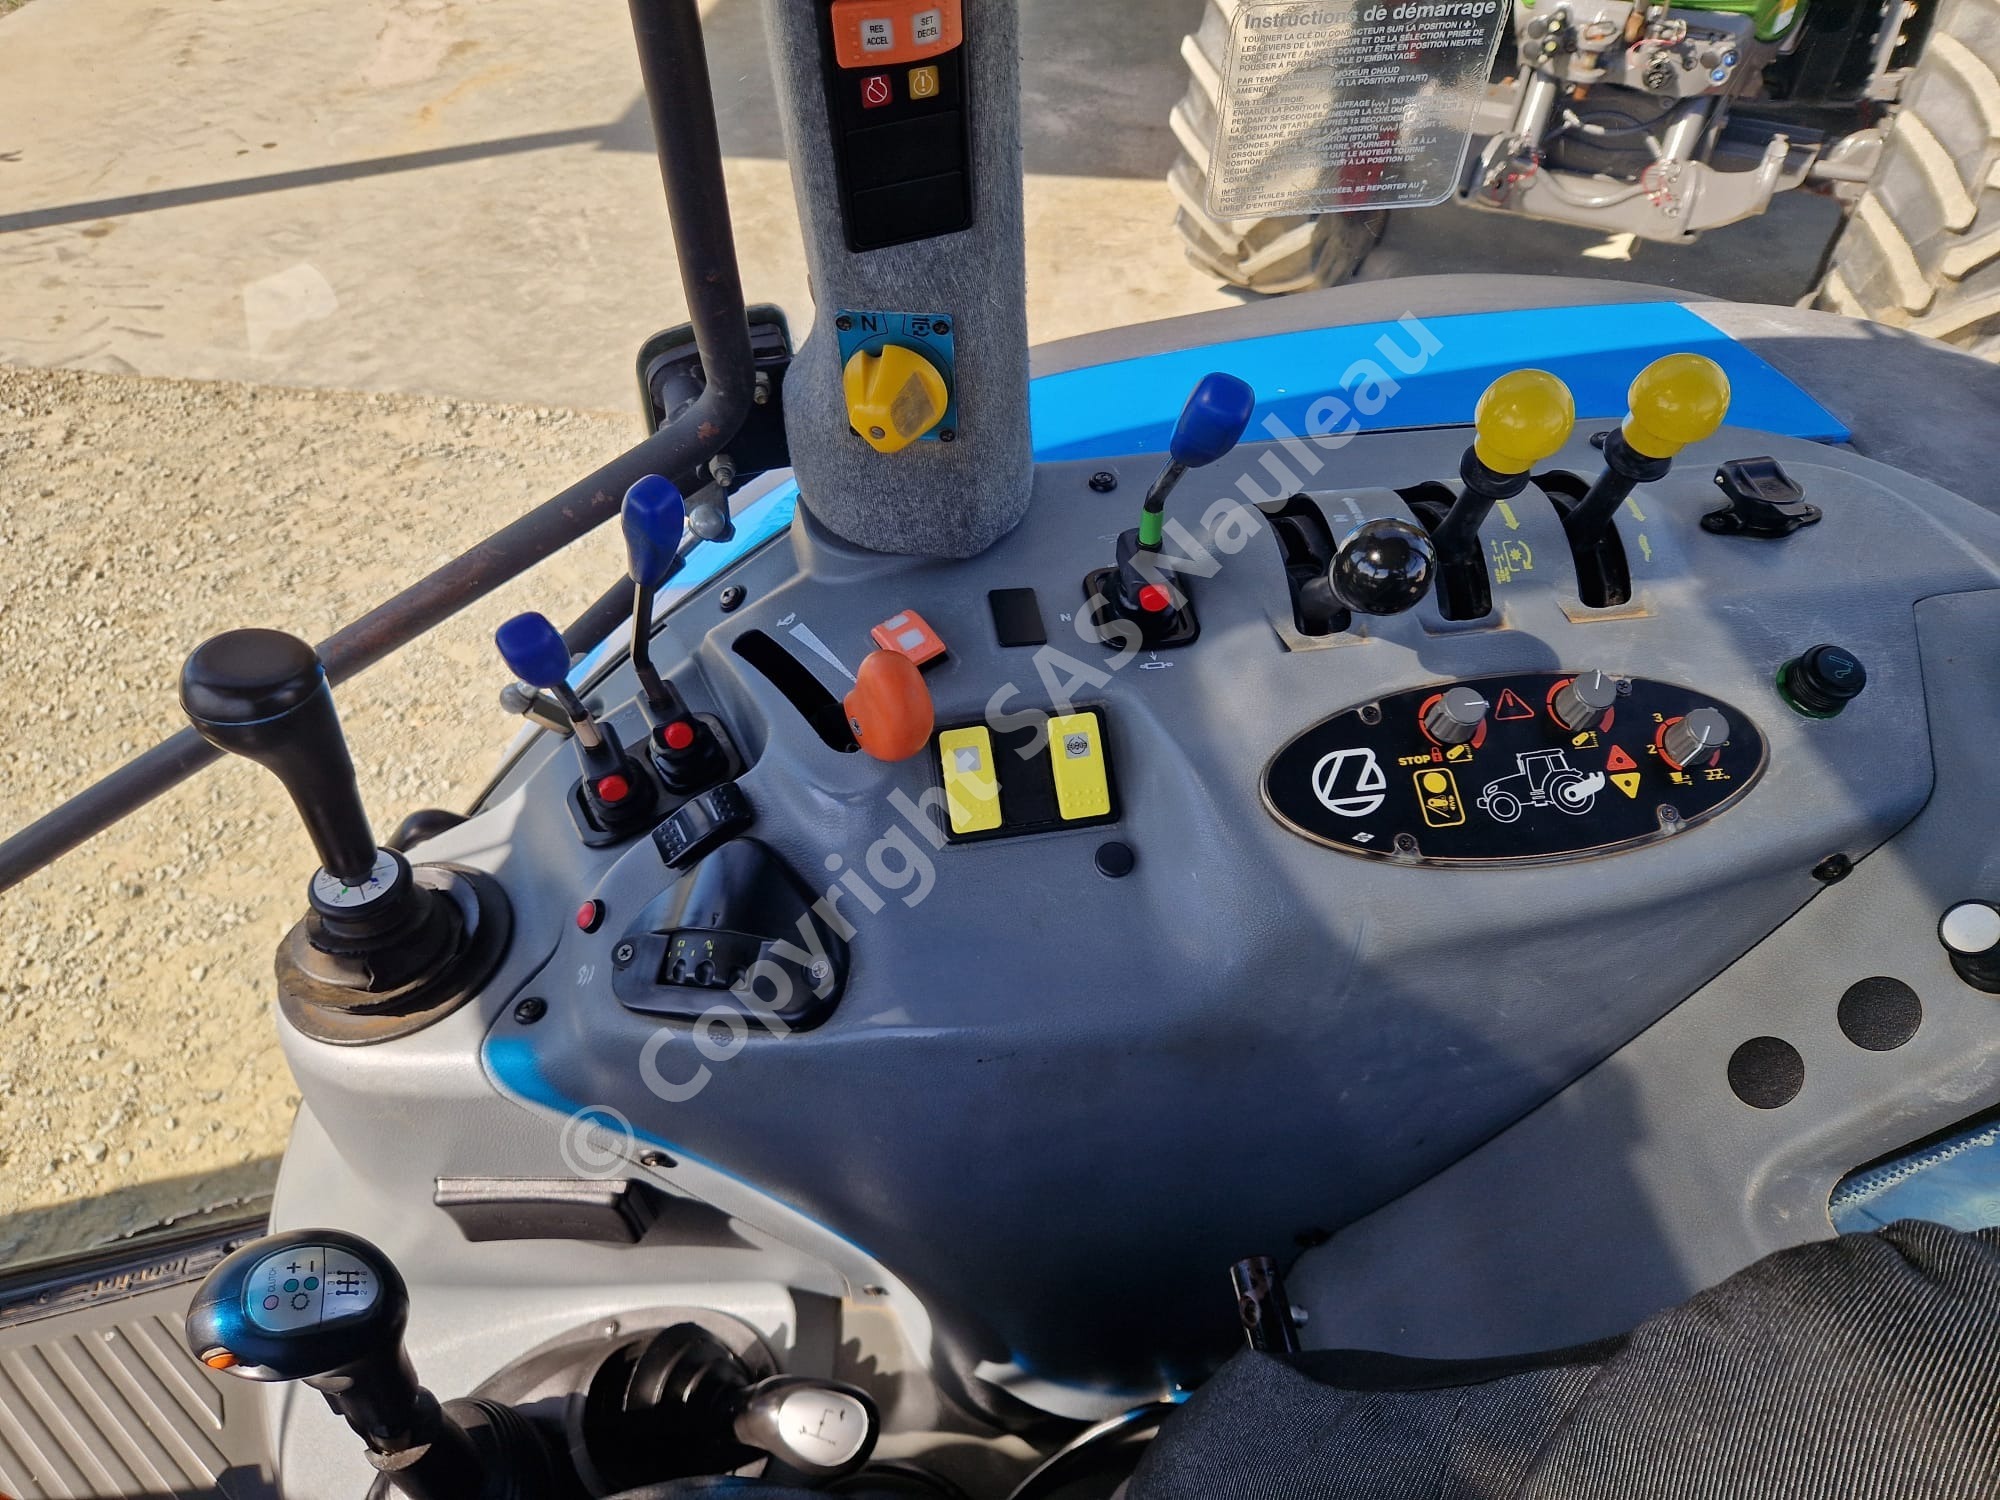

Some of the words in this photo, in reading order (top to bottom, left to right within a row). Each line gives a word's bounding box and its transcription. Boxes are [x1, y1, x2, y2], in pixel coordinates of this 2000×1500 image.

[1244, 9, 1358, 29] Instructions
[1392, 1, 1497, 20] démarrage
[921, 16, 934, 26] SET
[869, 25, 884, 33] RES
[1386, 24, 1404, 34] SUR
[1405, 23, 1416, 32] LA
[1418, 21, 1458, 32] POSITION
[917, 27, 938, 39] DECEL
[1362, 36, 1372, 44] ET
[1374, 36, 1386, 44] DE
[1387, 34, 1398, 42] LA
[1399, 30, 1446, 42] SÉLECTION
[1447, 29, 1471, 38] PRISE
[1472, 28, 1485, 36] DE
[867, 37, 888, 46] ACCEL
[1397, 42, 1409, 50] EN
[1410, 39, 1450, 50] POSITION
[1370, 66, 1400, 76] CHAUD
[1358, 76, 1396, 86] POSITION
[1354, 140, 1390, 149] TOURNER
[1347, 150, 1358, 158] LE
[1358, 147, 1392, 156] MOTEUR
[1394, 146, 1426, 154] TOURNE
[1356, 158, 1366, 166] LA
[1366, 155, 1403, 164] POSITION
[1404, 154, 1416, 162] DE
[1366, 182, 1408, 192] REPORTER
[861, 315, 878, 331] N
[1651, 712, 1664, 722] 3
[1646, 744, 1658, 754] 2
[1398, 755, 1431, 766] STOP
